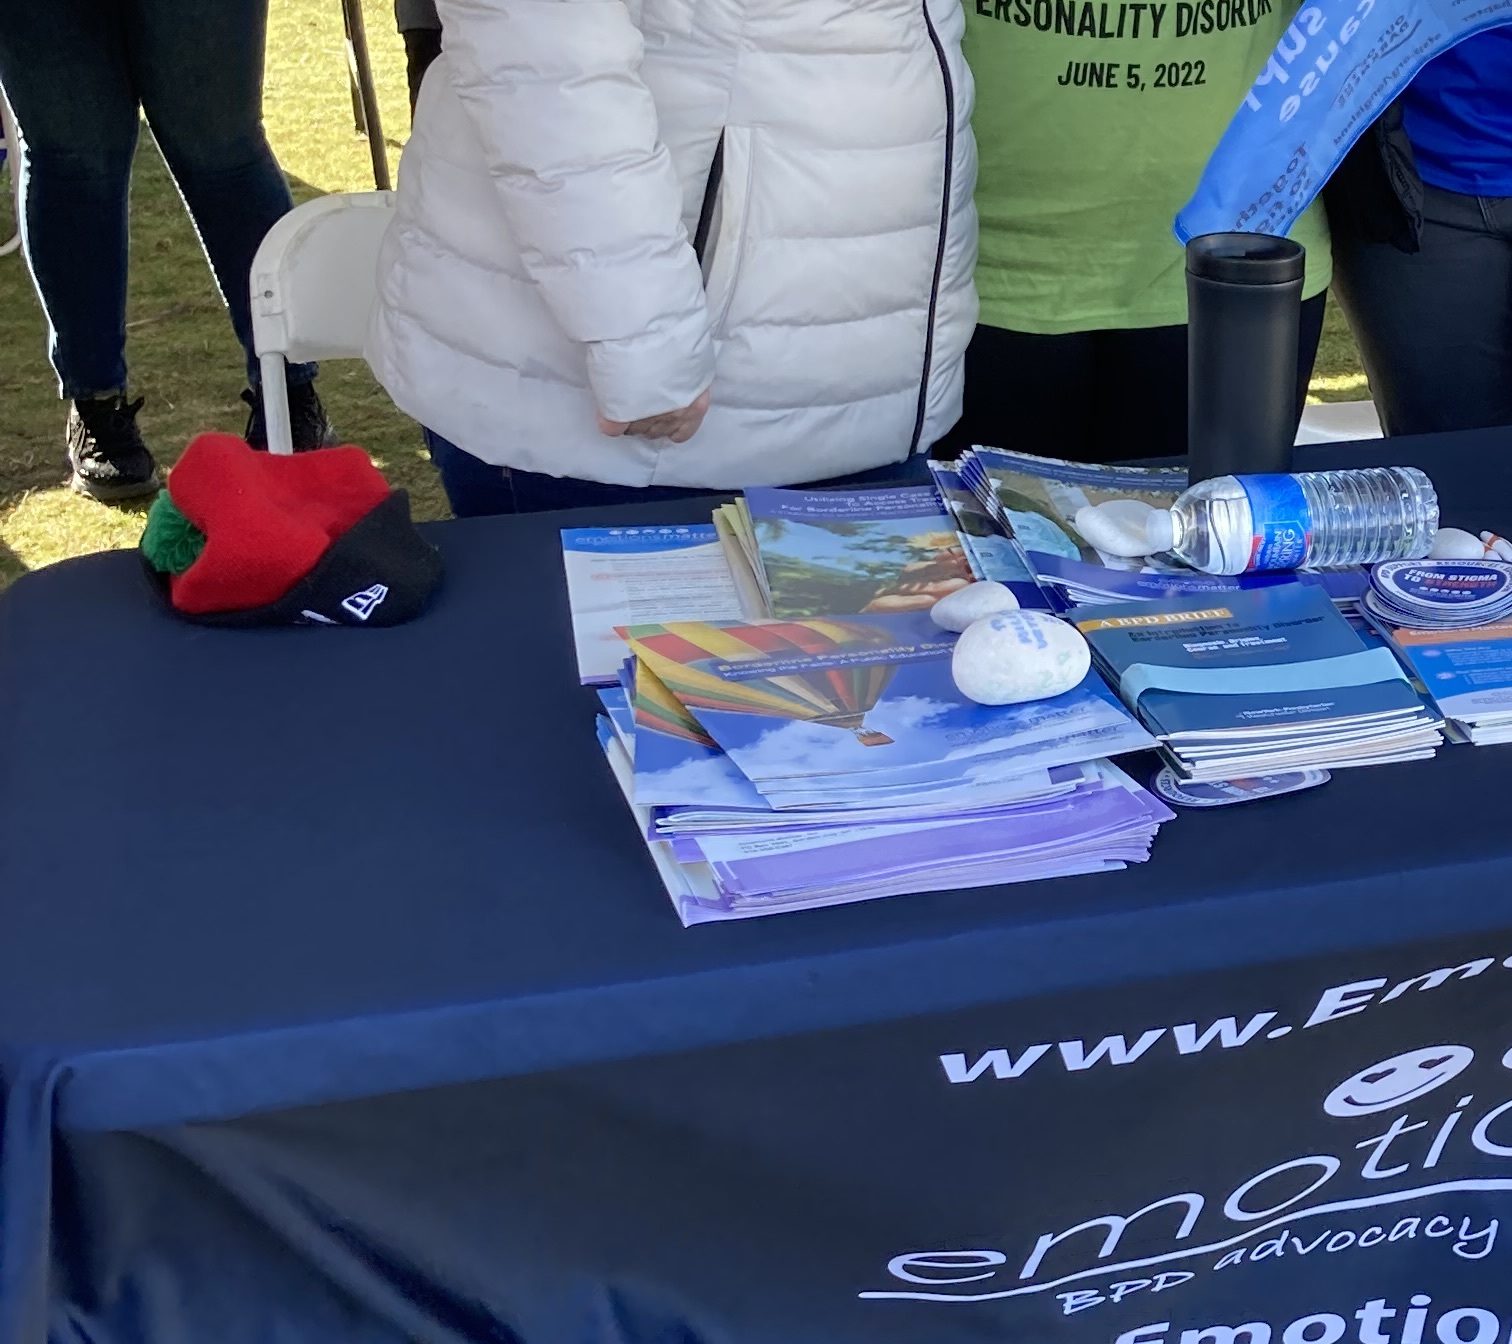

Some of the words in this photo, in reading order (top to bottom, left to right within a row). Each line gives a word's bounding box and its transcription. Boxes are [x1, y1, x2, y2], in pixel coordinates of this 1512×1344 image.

[1057, 60, 1120, 88] JUNE
[1126, 63, 1146, 92] 5,
[1153, 59, 1207, 89] 2022
[575, 532, 718, 546] emotionsmatte
[1403, 573, 1422, 583] TO
[1408, 569, 1446, 580] FROM
[1447, 573, 1499, 582] STIGMA
[1099, 619, 1114, 629] A
[1116, 616, 1166, 626] BPD
[1166, 608, 1228, 623] BRIEF
[1272, 616, 1326, 630] Disorder
[717, 654, 813, 672] Borderline
[816, 644, 917, 661] Personality
[722, 667, 777, 679] Knowing
[1056, 1269, 1196, 1316] BPD
[1212, 1212, 1501, 1271] advocacy
